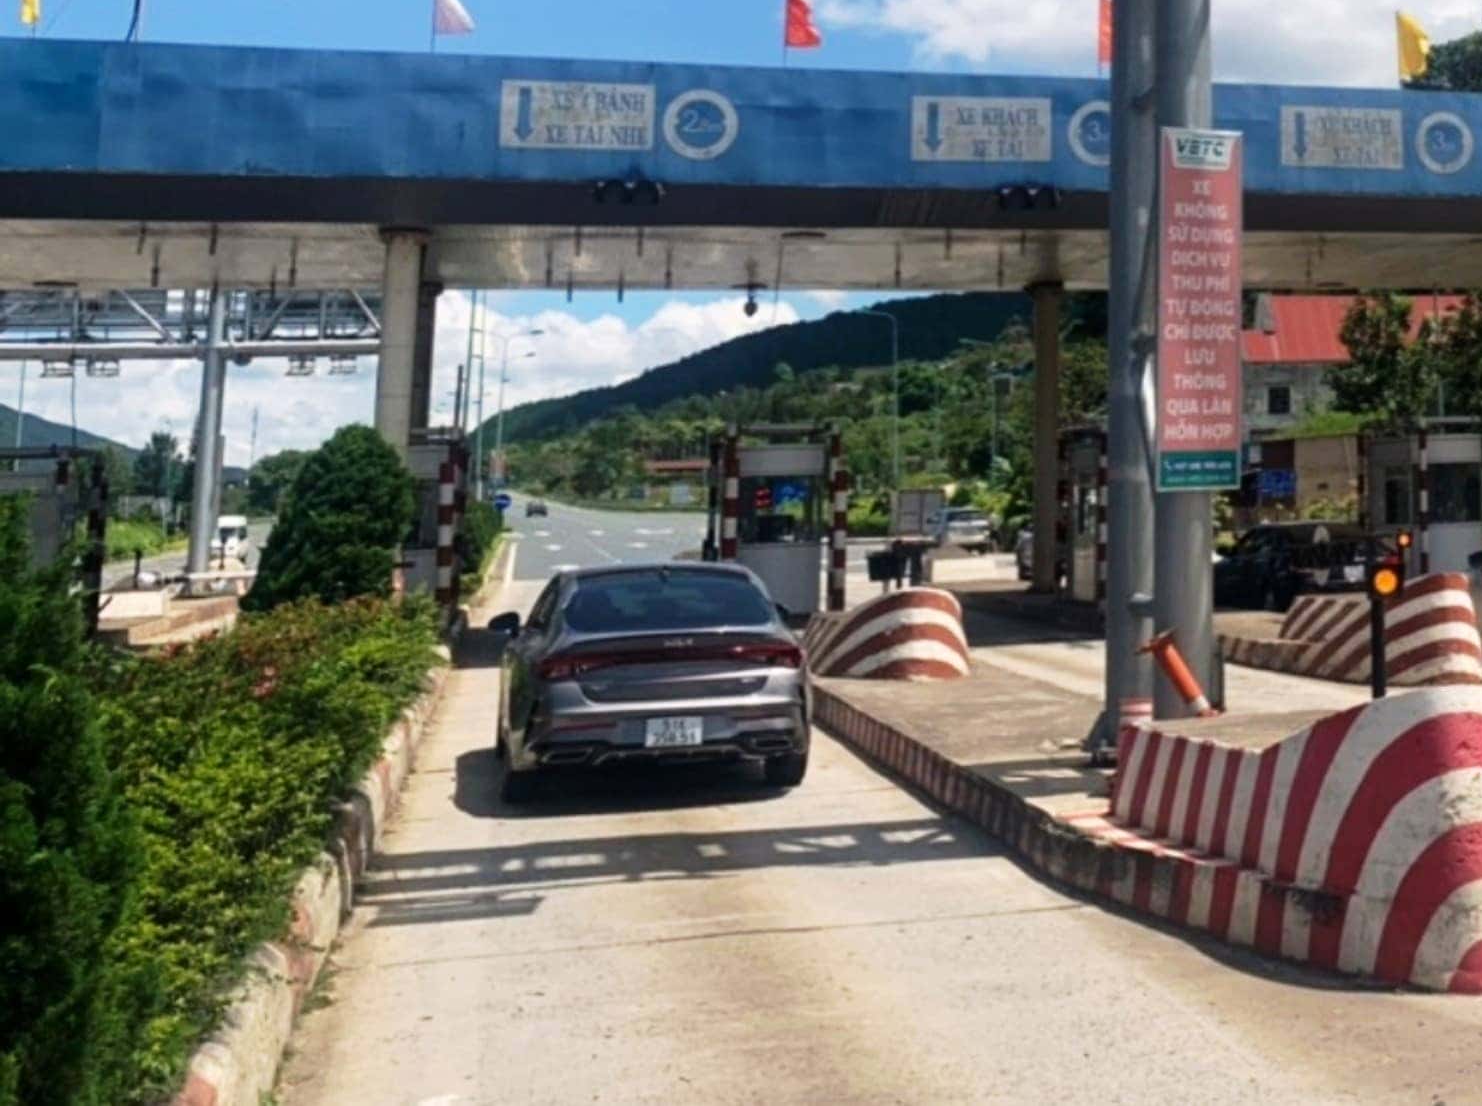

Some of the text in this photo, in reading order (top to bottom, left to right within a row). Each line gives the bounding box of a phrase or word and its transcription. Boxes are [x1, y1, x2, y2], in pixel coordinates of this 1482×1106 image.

[1175, 137, 1225, 157] VETC
[1174, 199, 1228, 220] KHÔNG
[1171, 275, 1201, 292] THU
[1173, 370, 1227, 390] THÔNG
[1165, 398, 1199, 416] QUA
